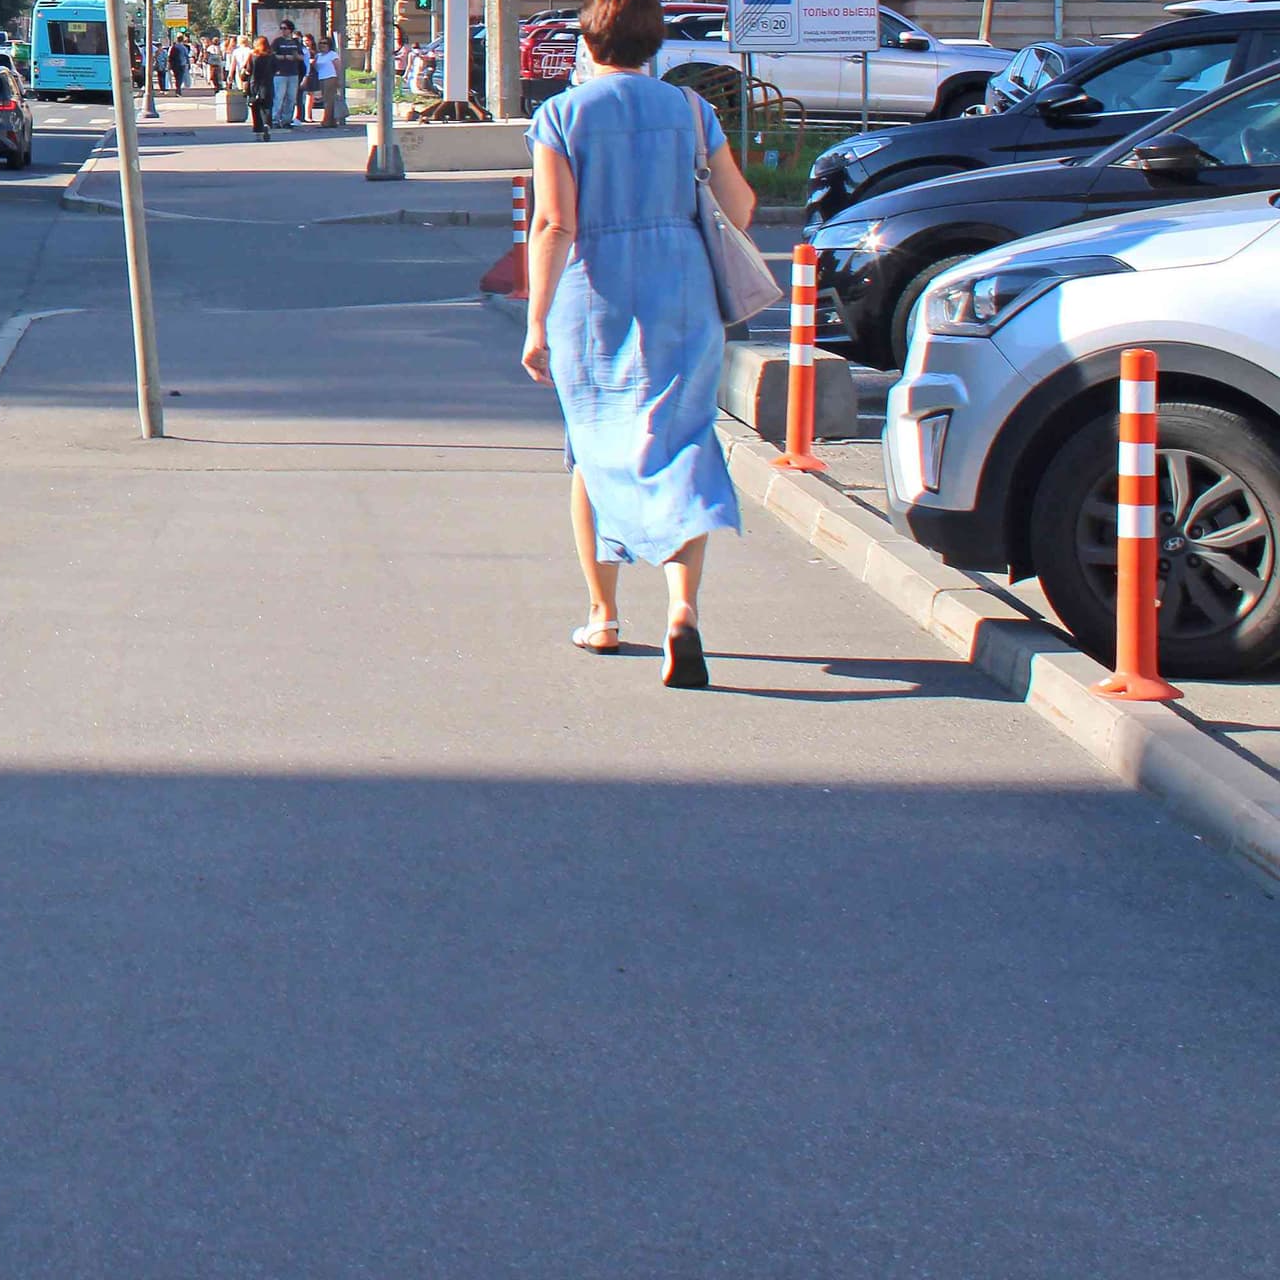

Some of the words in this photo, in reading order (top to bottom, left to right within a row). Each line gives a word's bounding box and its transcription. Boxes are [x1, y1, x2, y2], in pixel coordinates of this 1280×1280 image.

[802, 8, 840, 17] ТОЛЬКО
[842, 8, 876, 18] ВЫЕЗД
[772, 19, 787, 30] 20
